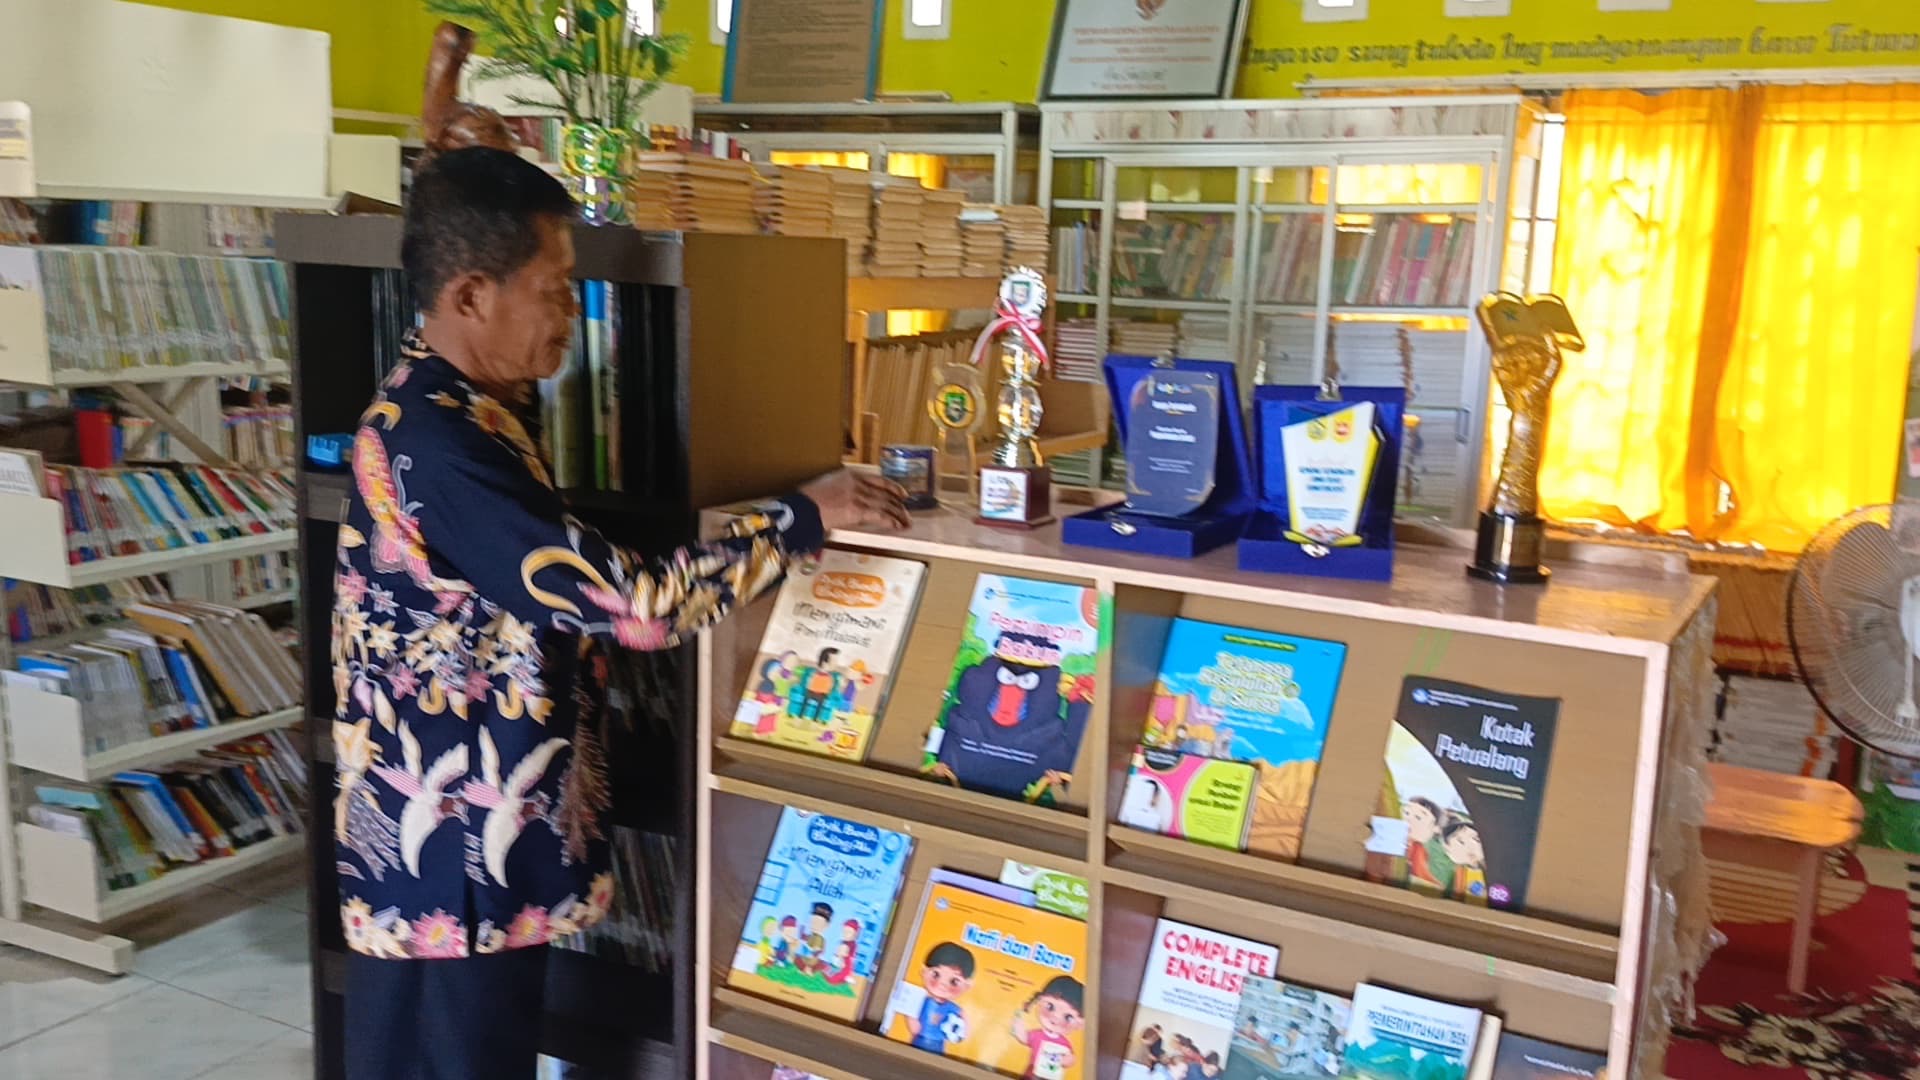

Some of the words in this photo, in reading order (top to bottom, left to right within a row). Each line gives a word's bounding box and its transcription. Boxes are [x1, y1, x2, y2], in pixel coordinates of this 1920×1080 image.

[1480, 714, 1535, 747] Kotak
[1434, 733, 1530, 780] Petualang
[1162, 930, 1270, 979] COMPLETE
